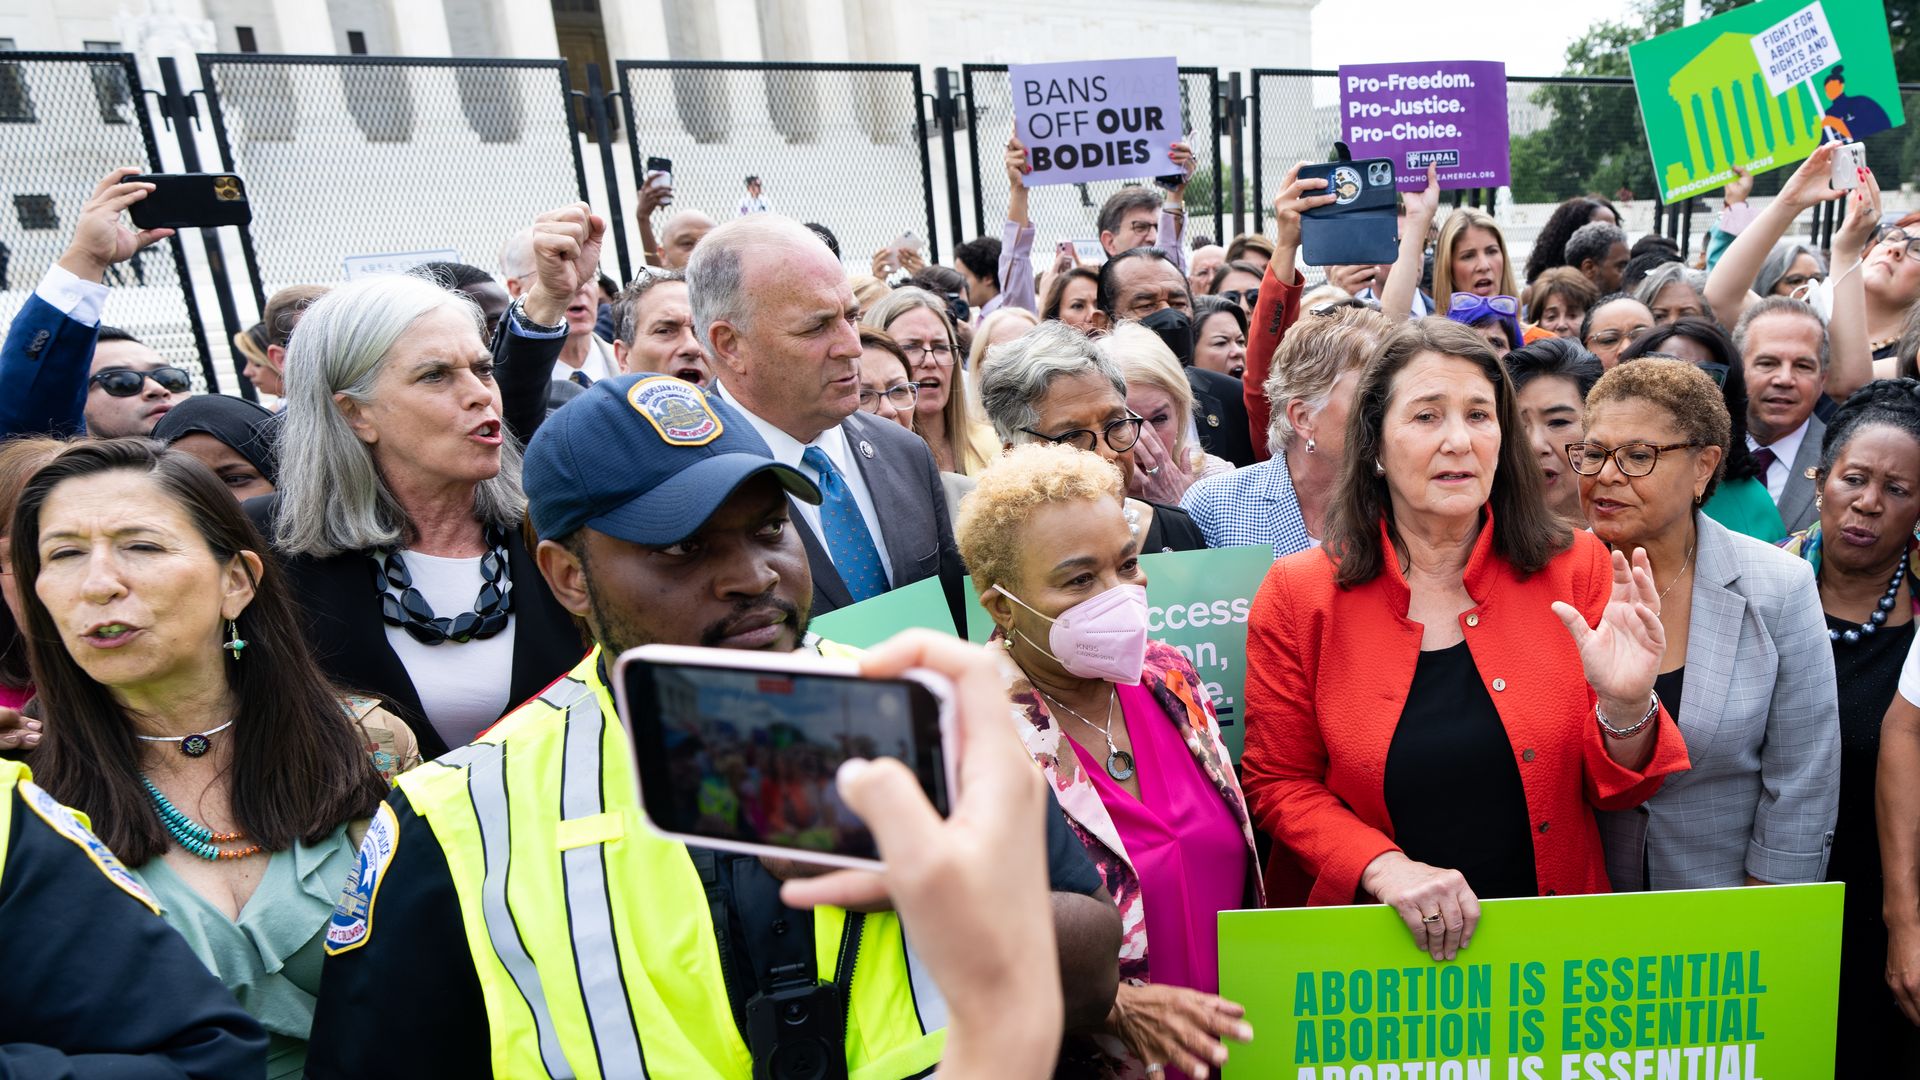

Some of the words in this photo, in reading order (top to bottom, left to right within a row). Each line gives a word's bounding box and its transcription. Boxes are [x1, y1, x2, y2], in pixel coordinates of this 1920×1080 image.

[1762, 24, 1791, 48] FIGHT
[1793, 11, 1814, 30] FOR
[1770, 25, 1818, 60] ABORTION
[1770, 49, 1805, 77] RIGHTS
[1808, 35, 1829, 55] AND
[1786, 54, 1824, 84] ACCESS
[1024, 75, 1108, 106] BANS
[1347, 70, 1475, 93] Pro-Freedom.
[1028, 110, 1089, 140] OFF
[1096, 106, 1165, 135] OUR
[1349, 95, 1466, 118] Pro-Justice.
[1350, 120, 1462, 143] Pro-Choice.
[1031, 139, 1150, 172] BODIES
[1421, 152, 1456, 162] NARAL
[1147, 597, 1250, 632] ccess
[1293, 963, 1492, 1017] ABORTION
[1509, 961, 1546, 1008] IS
[1562, 950, 1767, 1004] ESSENTIAL
[1294, 1011, 1491, 1064] ABORTION
[1508, 1008, 1545, 1055] IS
[1562, 997, 1765, 1052] ESSENTIAL
